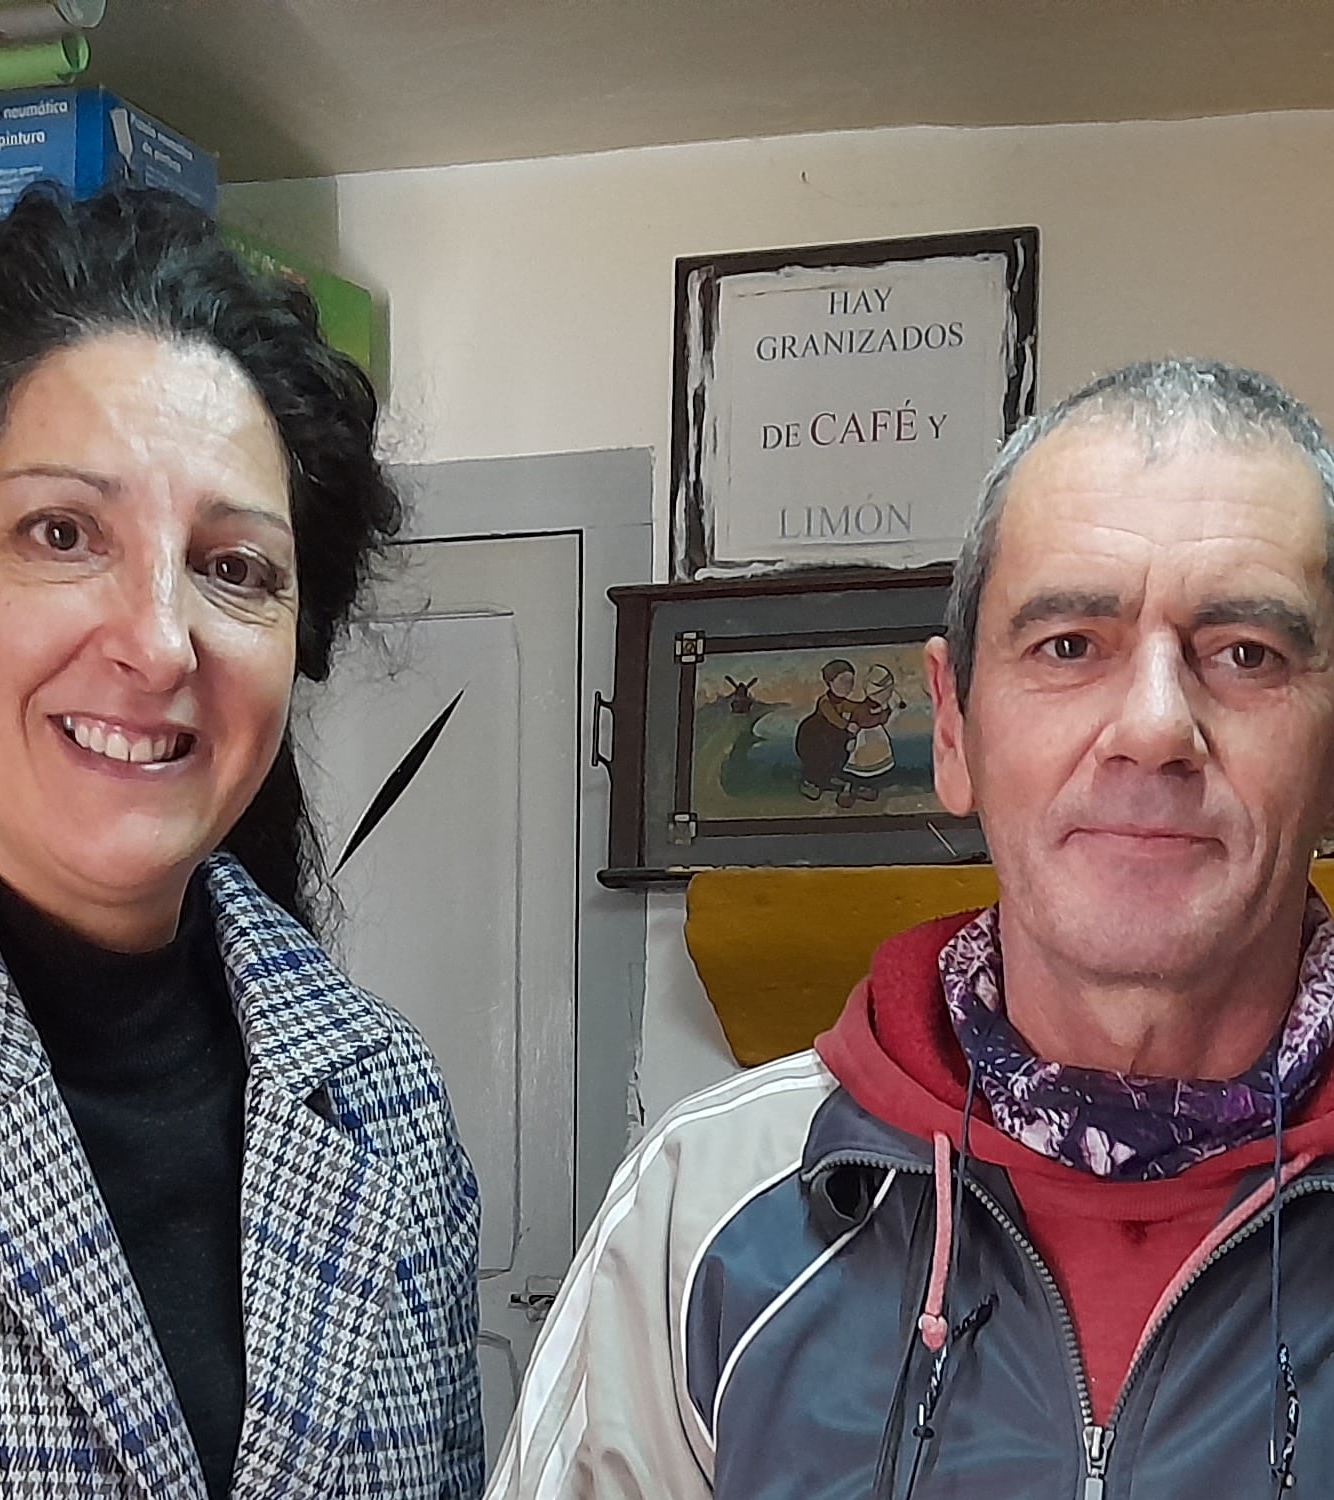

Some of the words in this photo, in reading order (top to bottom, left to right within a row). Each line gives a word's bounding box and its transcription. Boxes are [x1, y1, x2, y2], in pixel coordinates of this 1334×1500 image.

[827, 286, 893, 315] HAY
[755, 321, 965, 361] GRANIZADOS
[762, 423, 802, 450] DE
[809, 399, 919, 447] CAFÉ
[928, 414, 948, 440] Y
[777, 493, 914, 540] LIMÓN
